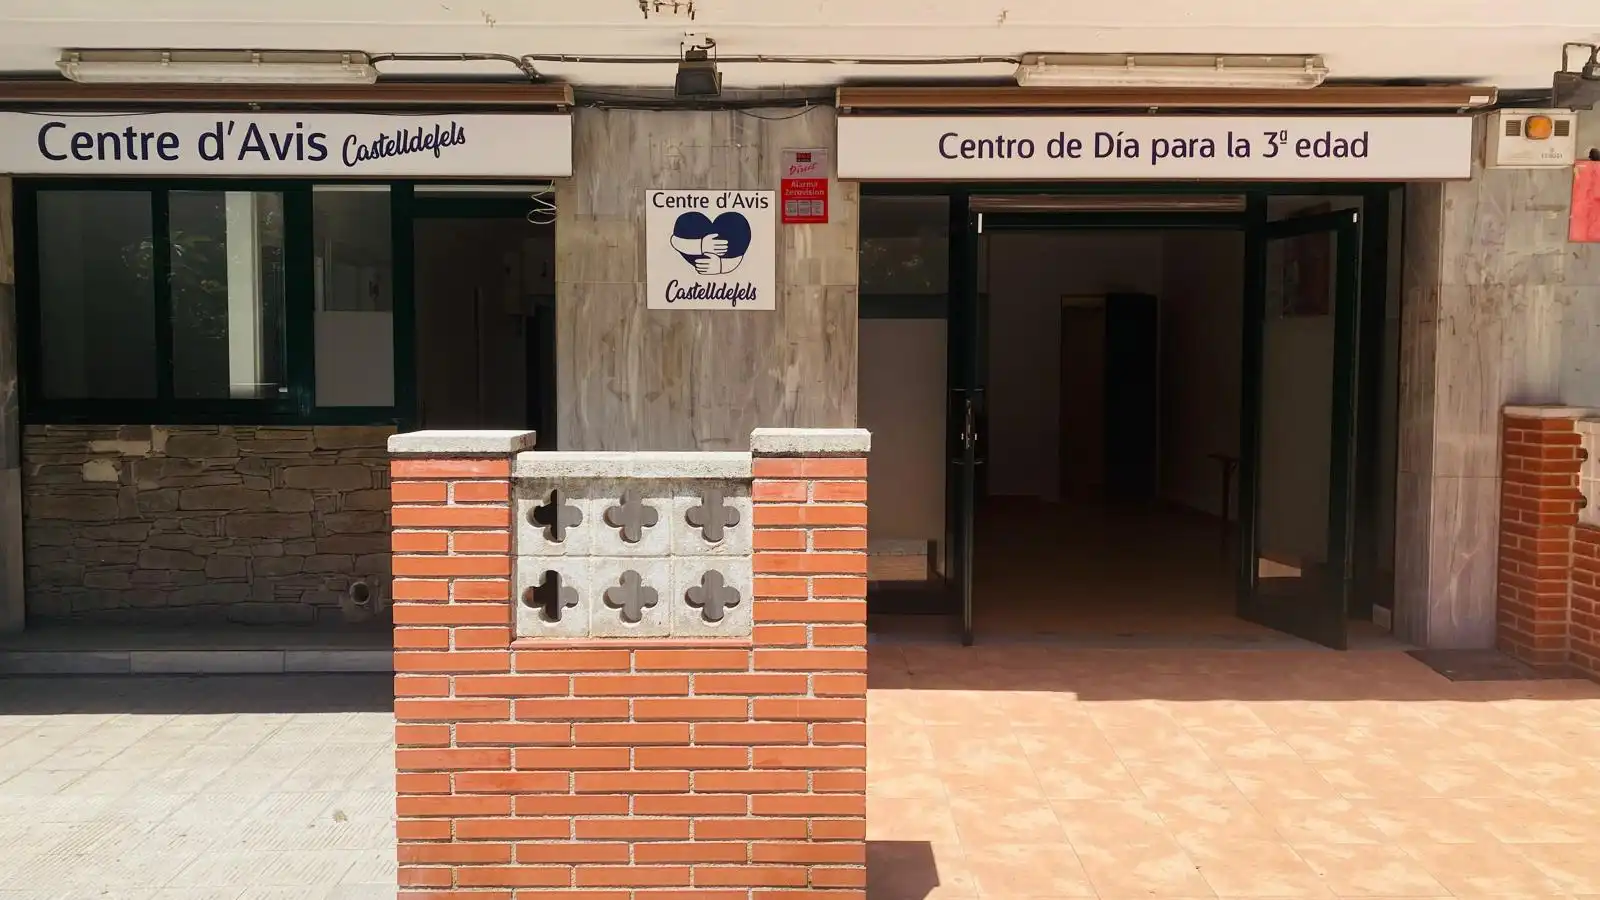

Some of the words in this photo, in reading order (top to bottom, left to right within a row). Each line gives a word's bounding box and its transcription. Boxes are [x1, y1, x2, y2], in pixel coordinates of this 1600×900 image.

[37, 121, 180, 161] Centre
[197, 120, 328, 162] d'Avis
[342, 120, 466, 168] Castelldefels
[938, 132, 1035, 160] Centro
[1046, 131, 1083, 159] de
[1094, 131, 1140, 159] Día
[1151, 138, 1215, 166] para
[1227, 131, 1251, 159] la
[1262, 129, 1288, 159] 3ª
[1295, 130, 1369, 159] edad
[652, 192, 709, 208] Centre
[716, 192, 769, 209] d'Avis
[665, 279, 757, 307] Castelldefels
